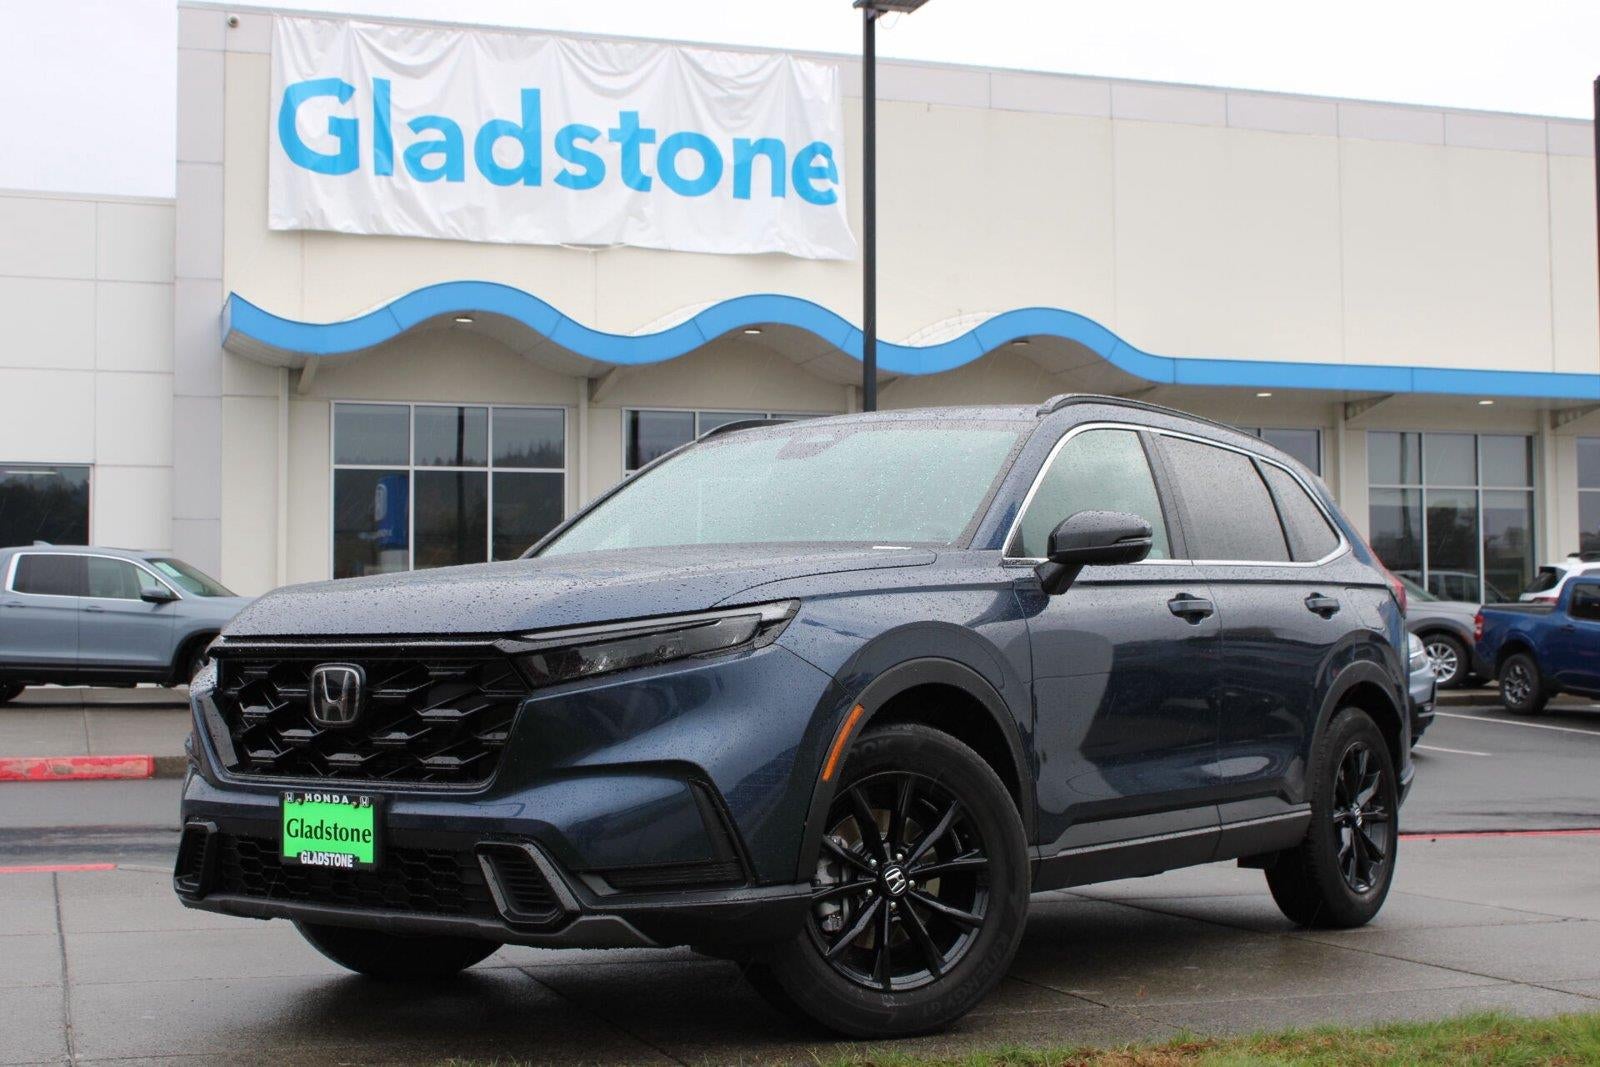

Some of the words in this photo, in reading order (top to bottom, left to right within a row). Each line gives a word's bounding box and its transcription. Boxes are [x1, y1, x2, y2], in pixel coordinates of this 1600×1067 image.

[278, 77, 839, 206] Gladstone
[304, 793, 349, 804] HONDA
[286, 818, 372, 843] Gladstone
[301, 851, 353, 868] GLADSTONE
